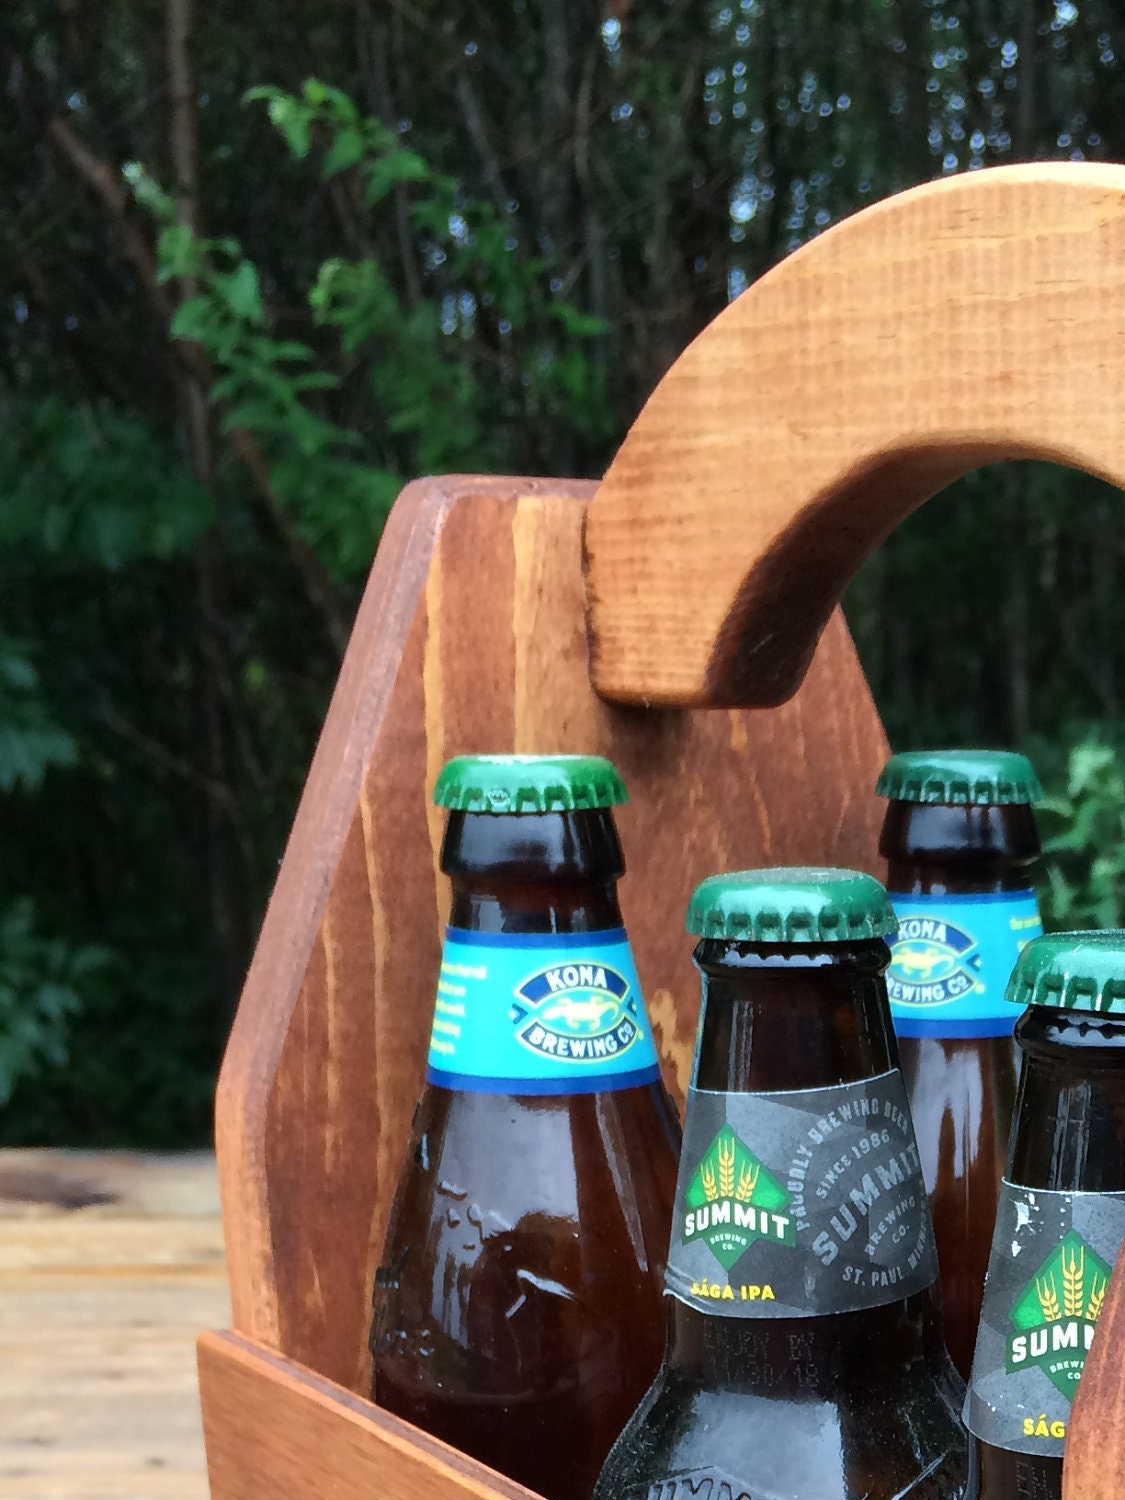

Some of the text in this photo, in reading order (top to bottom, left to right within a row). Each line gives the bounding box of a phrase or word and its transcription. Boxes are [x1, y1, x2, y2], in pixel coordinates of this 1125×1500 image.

[897, 919, 948, 943] KONA
[544, 965, 608, 993] KONA
[886, 976, 945, 1002] REWING
[528, 1025, 618, 1058] BREWING
[787, 1145, 813, 1232] PROUDLY
[807, 1097, 880, 1145] BREWING
[815, 1128, 891, 1200] SINCE 1986
[811, 1141, 920, 1267] SUMMIT
[684, 1200, 790, 1240] SUMMIT
[864, 1194, 916, 1257] BREWING
[709, 1232, 748, 1247] BREWING
[689, 1277, 776, 1301] SÁGA IPA
[870, 1264, 905, 1287] PAUL
